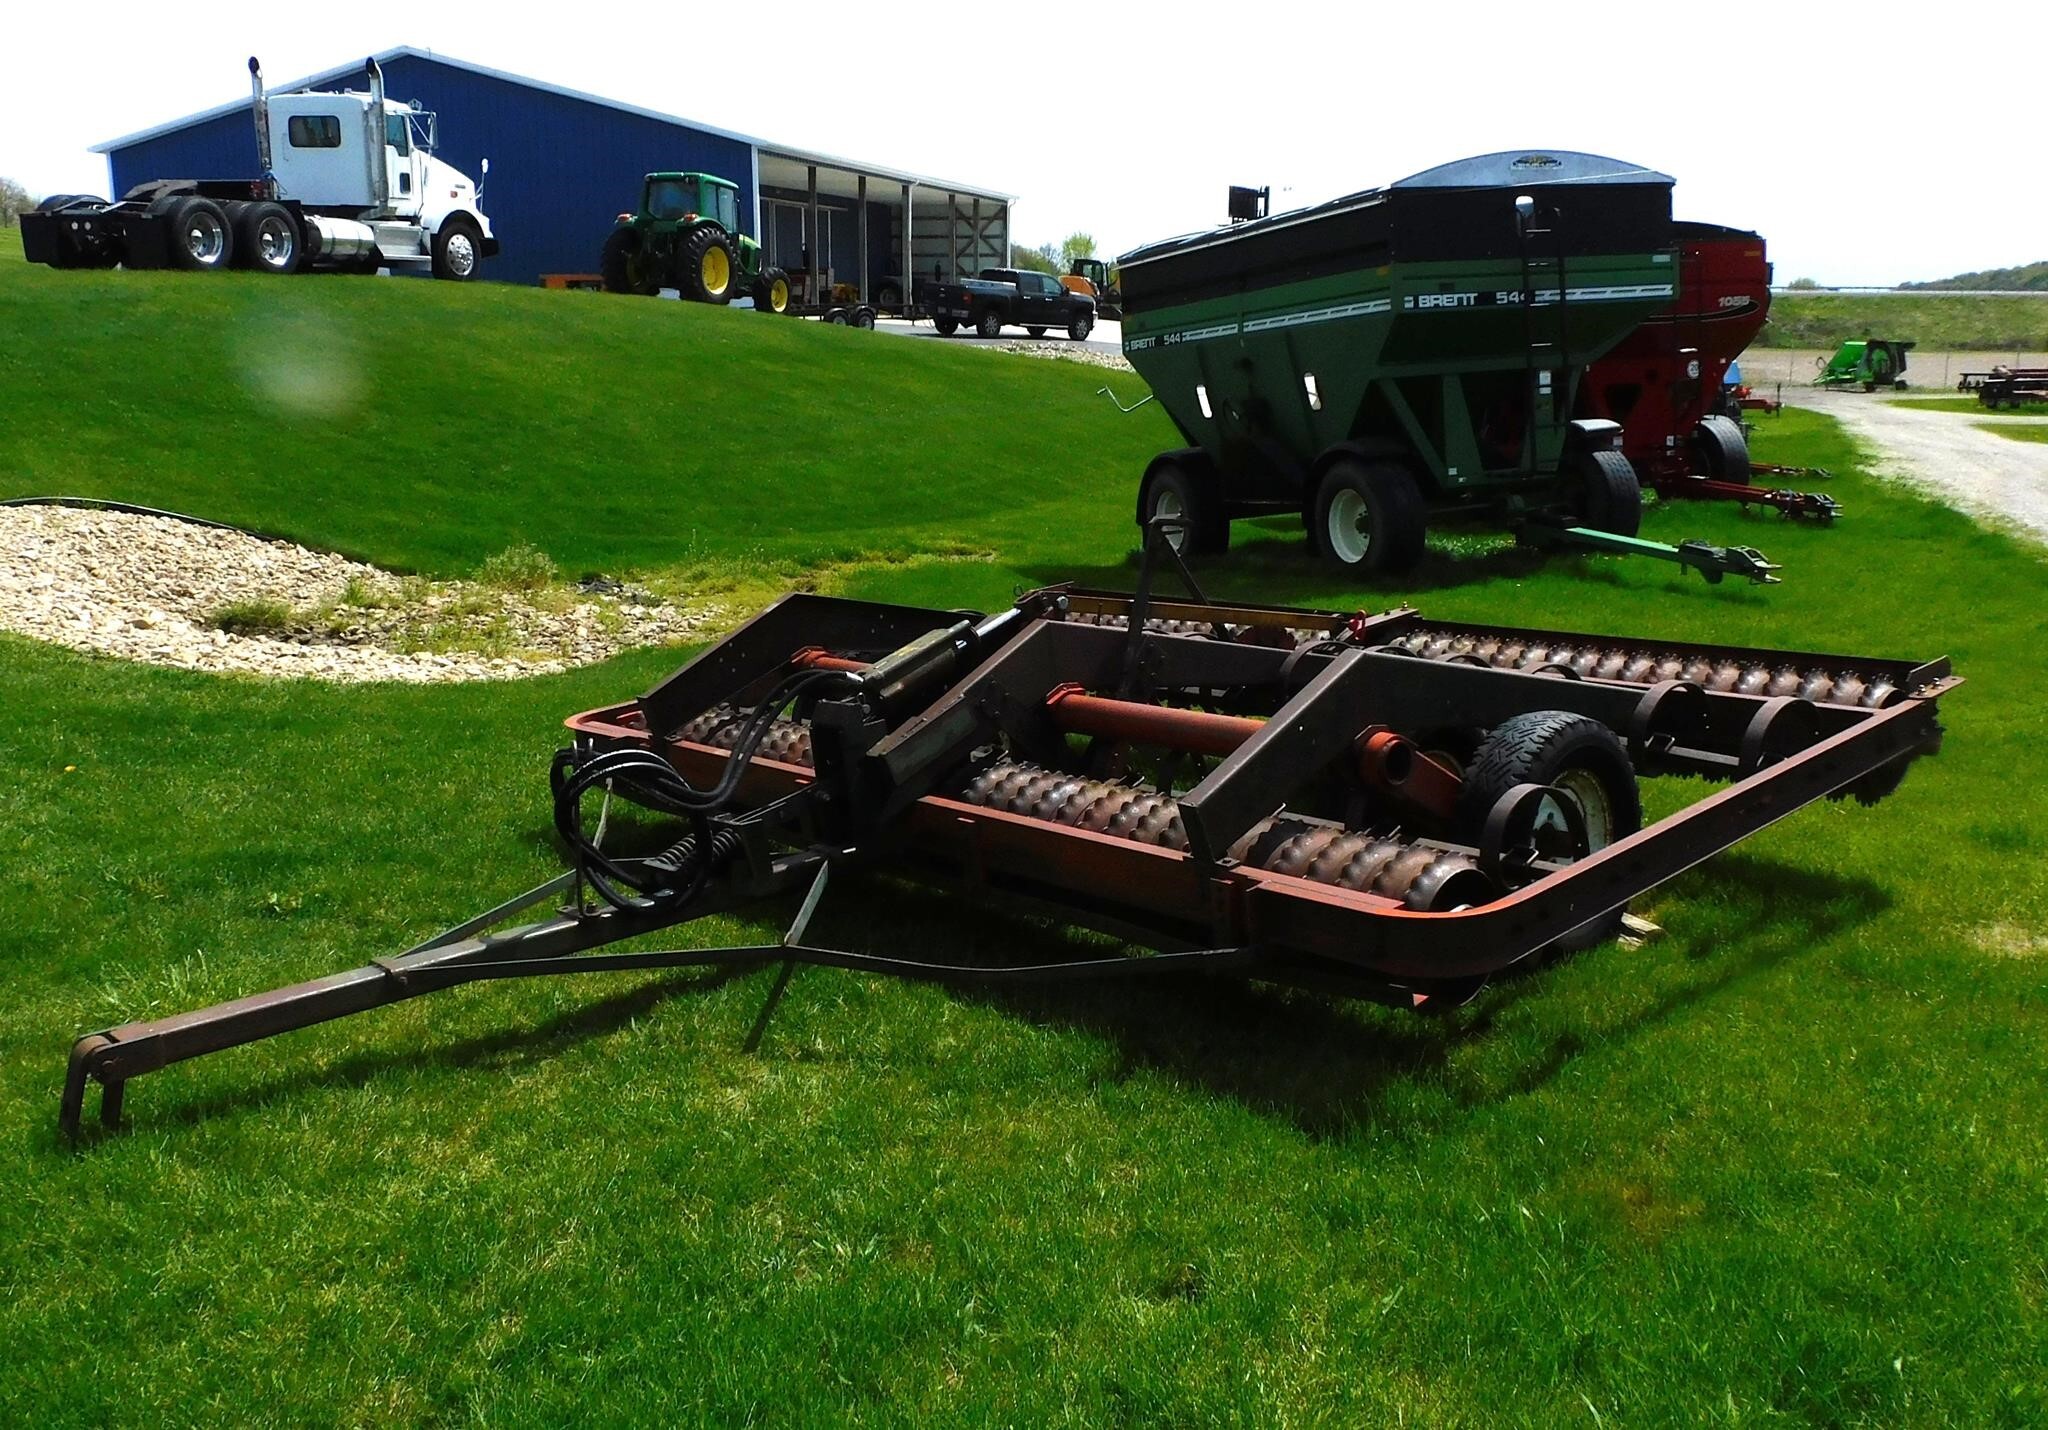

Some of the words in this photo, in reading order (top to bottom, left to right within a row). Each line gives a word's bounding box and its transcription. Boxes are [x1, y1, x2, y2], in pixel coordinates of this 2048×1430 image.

[1418, 293, 1478, 308] BRENT
[1130, 337, 1156, 350] BRENT
[1164, 332, 1181, 345] 544
